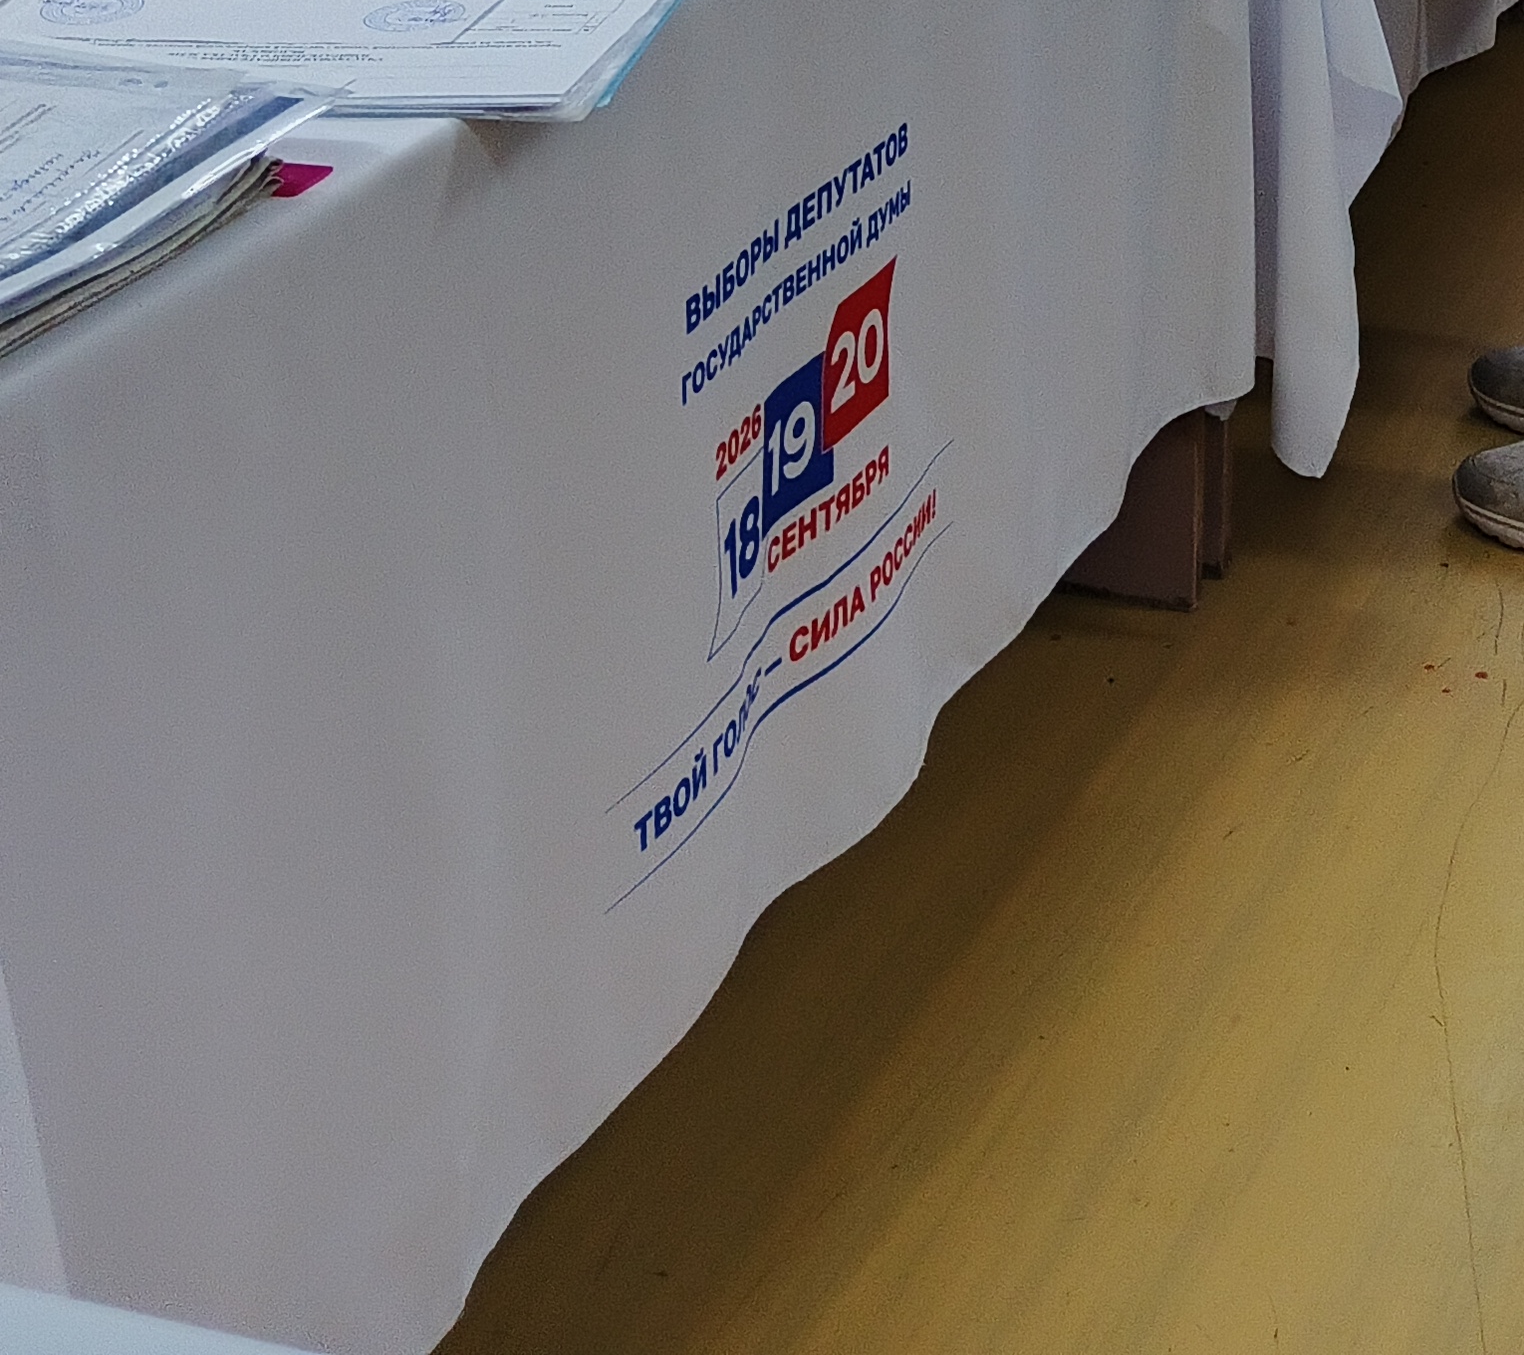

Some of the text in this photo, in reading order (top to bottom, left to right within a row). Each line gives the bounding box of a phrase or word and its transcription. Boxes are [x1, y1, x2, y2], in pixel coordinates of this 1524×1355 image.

[681, 178, 912, 407] ГОСУДАРСТВЕННОЙ ДУМЫ
[686, 122, 909, 335] ВЫБОРЫ ДЕПУТАТОВ
[715, 402, 763, 481] 2026
[723, 307, 885, 600] 18 19 20
[767, 443, 890, 574] СЕНТЯБРЯ
[634, 748, 708, 851] ТВОЙ
[788, 584, 866, 664] СИЛА
[868, 487, 938, 604] РОССИИ!
